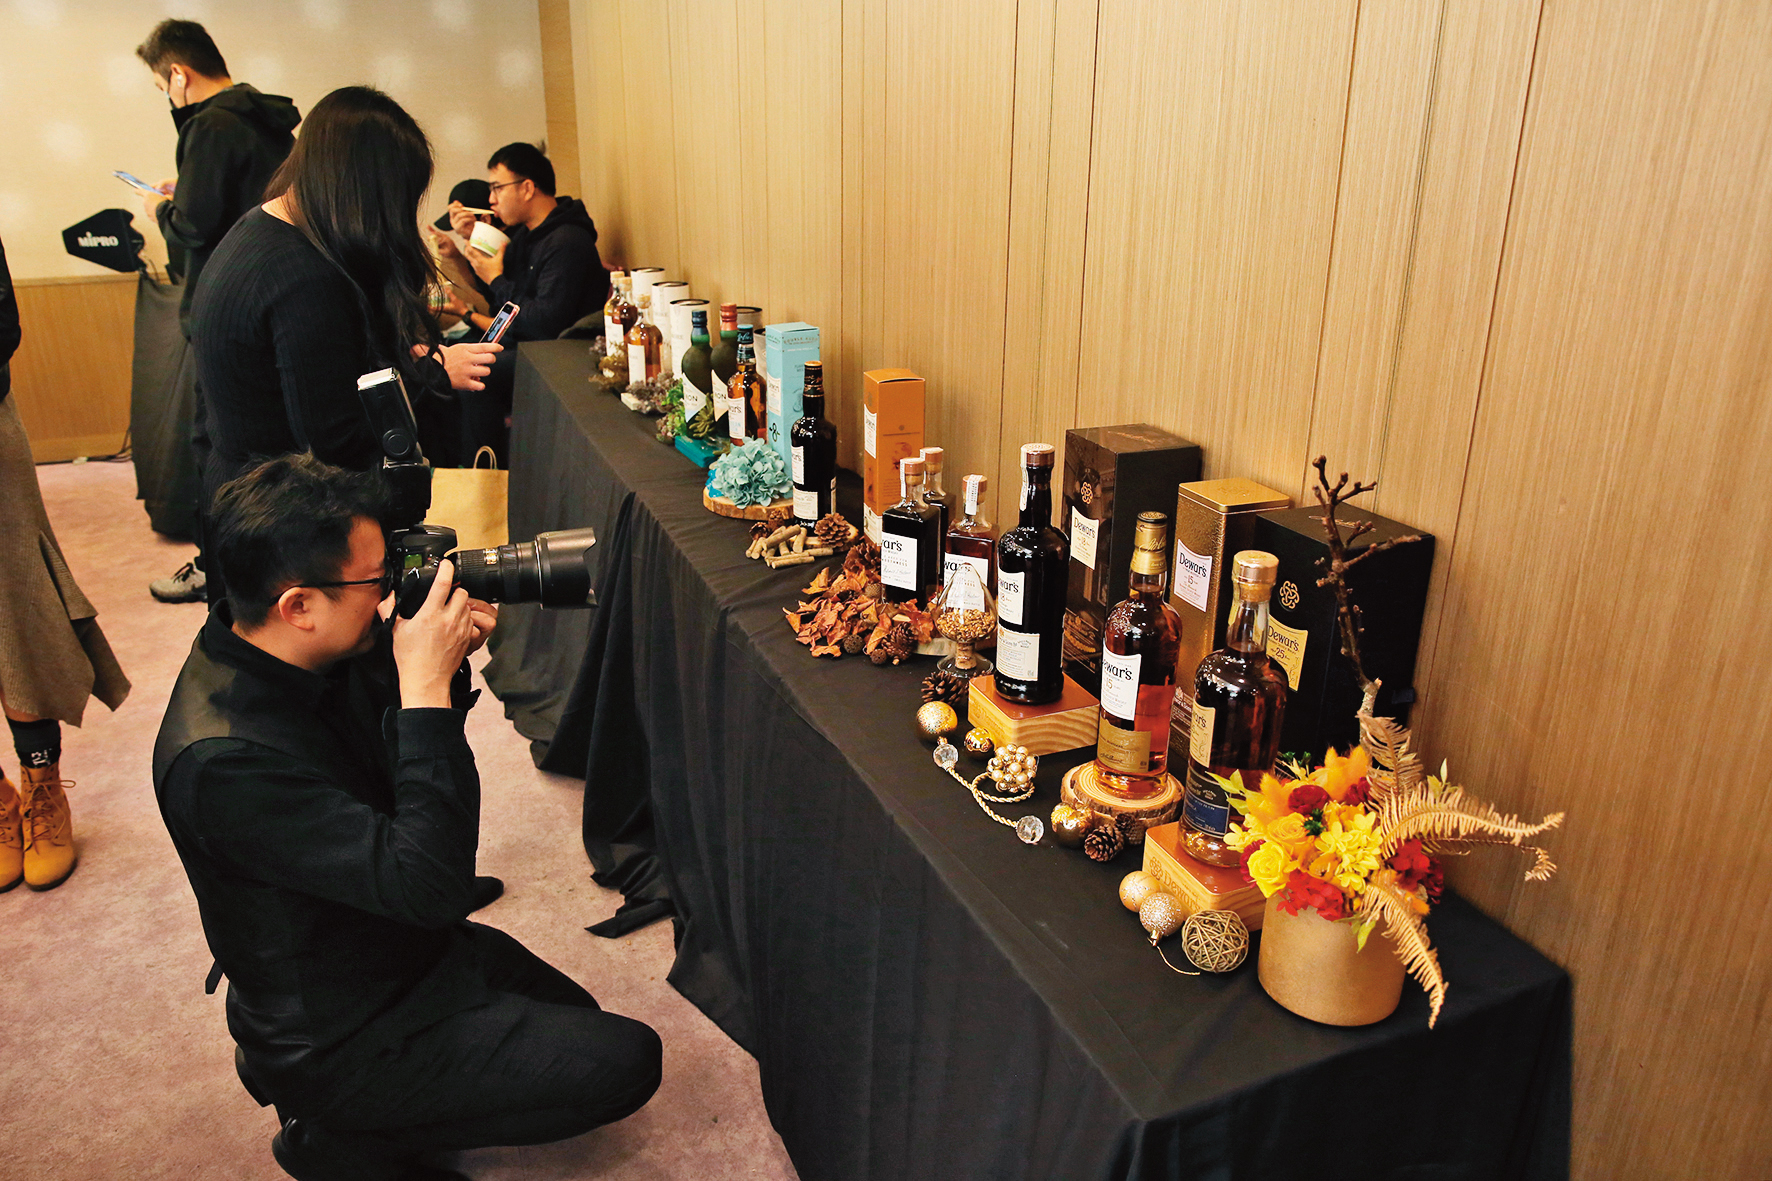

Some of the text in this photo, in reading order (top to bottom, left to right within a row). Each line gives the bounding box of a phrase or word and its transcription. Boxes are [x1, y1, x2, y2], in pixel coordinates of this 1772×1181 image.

[1073, 516, 1096, 539] Dewar's
[1179, 552, 1208, 578] Dewar's
[1268, 625, 1300, 652] Dewar's
[1275, 647, 1286, 659] 25
